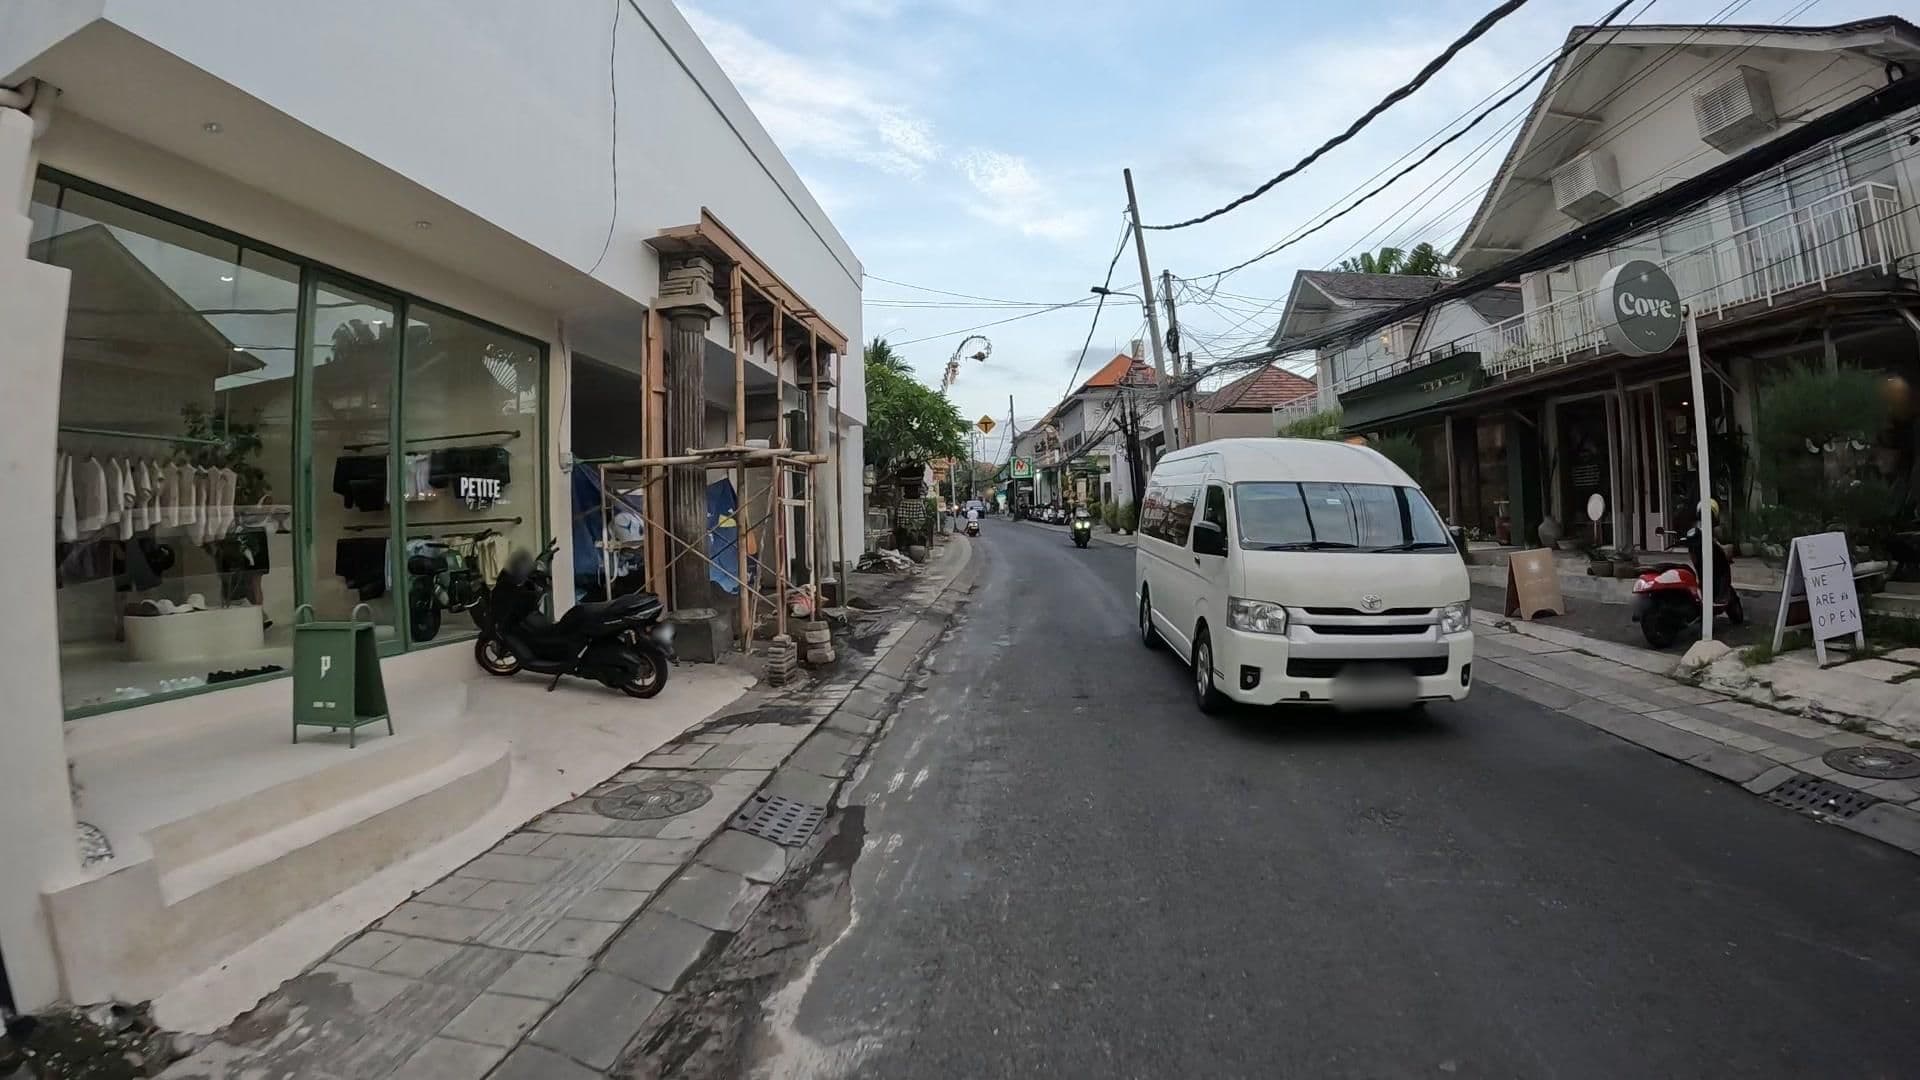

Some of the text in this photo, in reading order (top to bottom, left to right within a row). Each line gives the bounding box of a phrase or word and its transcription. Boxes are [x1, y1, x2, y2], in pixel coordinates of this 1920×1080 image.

[1619, 292, 1676, 318] Cove.
[460, 476, 501, 498] PETITE
[1811, 574, 1828, 587] WE
[1815, 592, 1836, 607] ARE
[1819, 608, 1857, 627] OPEN
